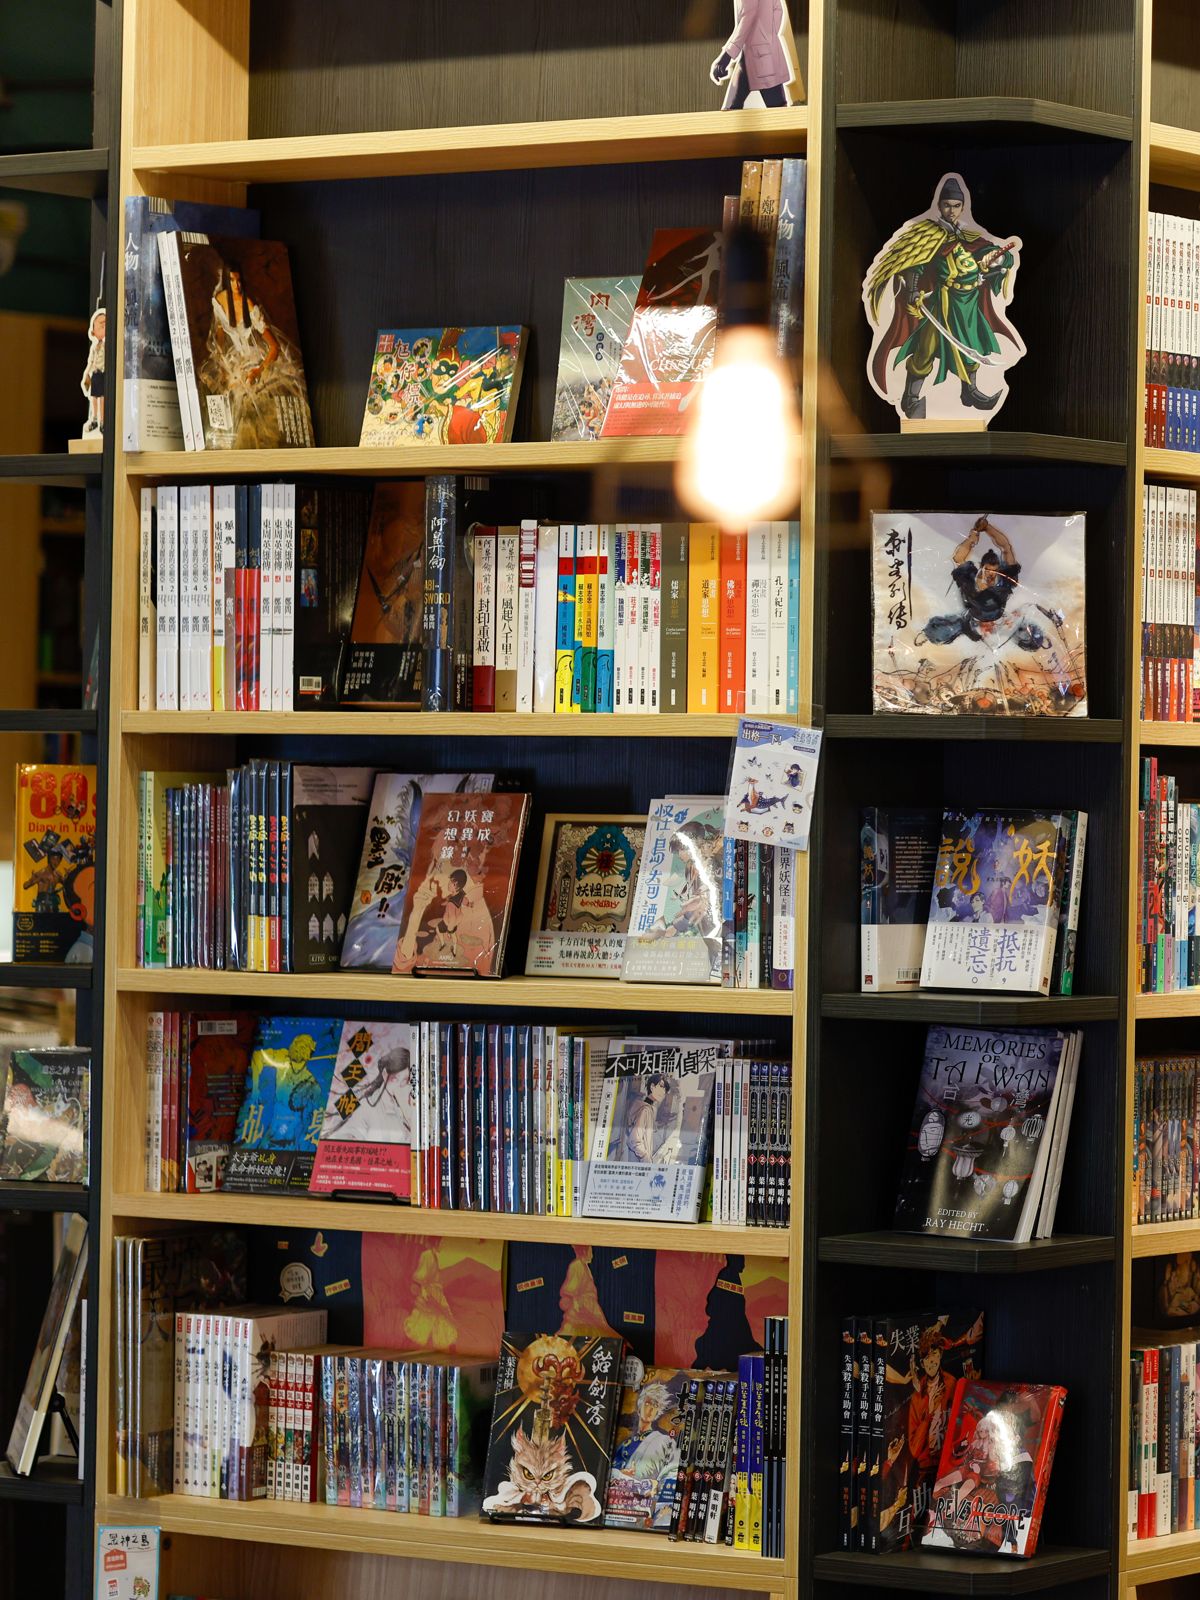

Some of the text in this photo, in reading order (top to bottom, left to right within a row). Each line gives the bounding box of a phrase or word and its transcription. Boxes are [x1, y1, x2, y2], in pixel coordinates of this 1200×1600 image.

[777, 198, 795, 241] 人物
[124, 232, 140, 271] 人物
[428, 517, 446, 570] 阿鼻劍
[423, 592, 451, 604] SWORD
[424, 579, 440, 589] ABI-
[774, 576, 784, 618] 孔子紀行
[501, 597, 513, 655] 風起八千里
[29, 823, 56, 833] Diary
[60, 822, 69, 833] in
[575, 883, 627, 898] 妖怪日記
[605, 1047, 716, 1078] 不可知論偵探
[942, 1034, 1046, 1060] MEMORIES
[981, 1054, 1001, 1064] OF
[338, 1032, 373, 1114] 閻王帖
[930, 1057, 1051, 1092] TAIWAN
[925, 1217, 985, 1232] RAY HECHT
[937, 1208, 978, 1219] EDITED BY
[889, 1325, 920, 1356] 失業
[585, 1345, 613, 1425] 貓劍客
[842, 1355, 853, 1419] 失業殺手互助會
[859, 1355, 870, 1419] 失業殺手互助會
[874, 1358, 886, 1422] 失業殺手互助會
